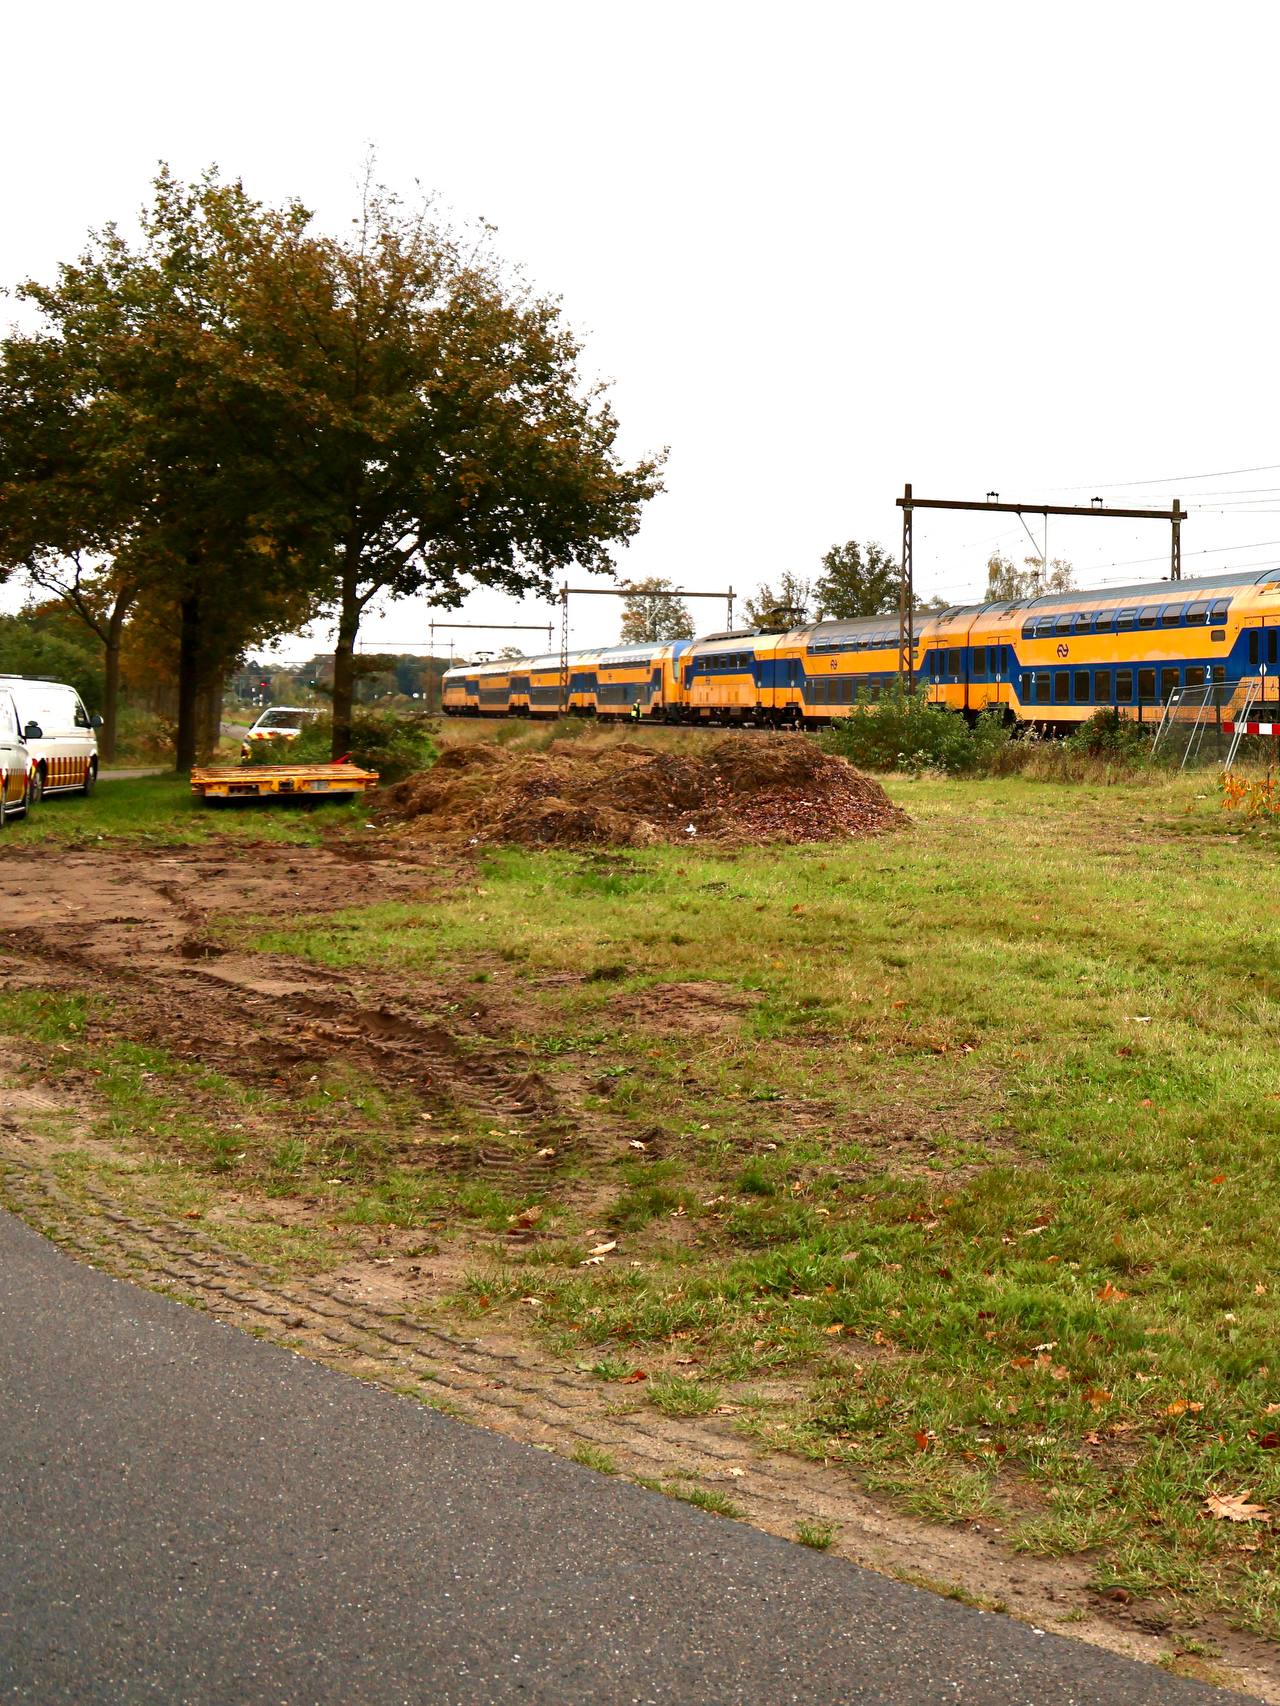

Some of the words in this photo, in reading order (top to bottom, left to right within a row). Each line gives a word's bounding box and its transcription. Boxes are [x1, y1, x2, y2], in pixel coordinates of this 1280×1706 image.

[1205, 611, 1211, 624] 2
[1031, 671, 1036, 683] 2
[1206, 665, 1211, 679] 2
